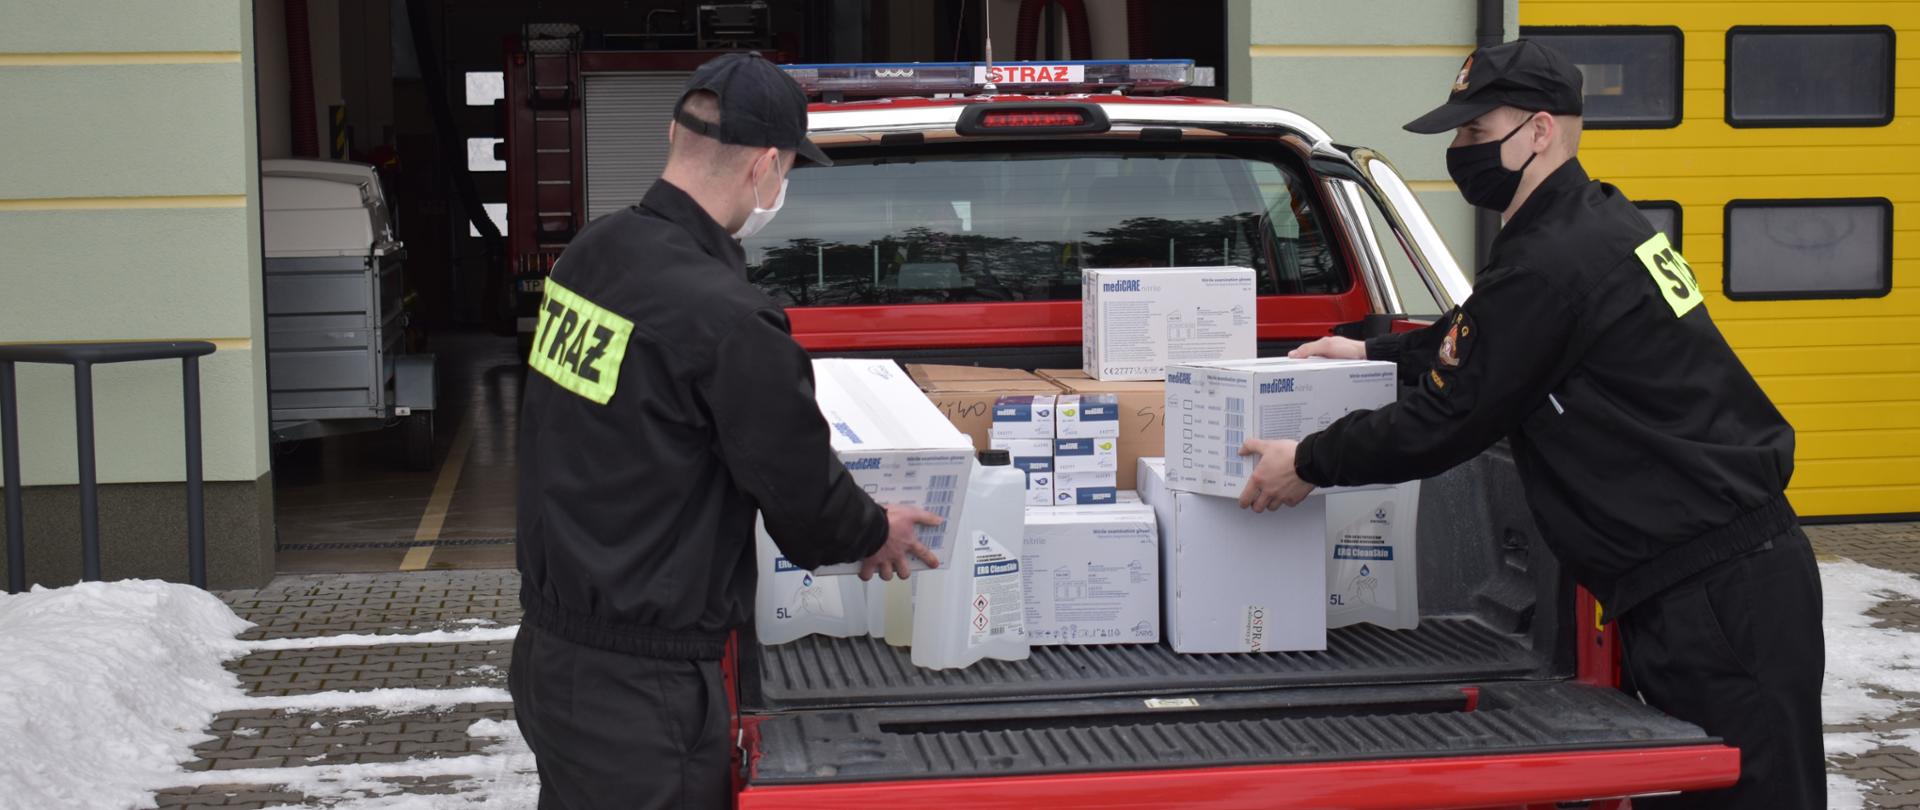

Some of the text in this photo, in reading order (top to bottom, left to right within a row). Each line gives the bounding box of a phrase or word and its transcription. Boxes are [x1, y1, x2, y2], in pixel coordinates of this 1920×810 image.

[1103, 279, 1141, 292] mediCARE
[537, 293, 615, 384] TRAŻ
[1259, 377, 1295, 394] mediCARE
[1329, 594, 1345, 606] 5L
[776, 607, 792, 619] 5L
